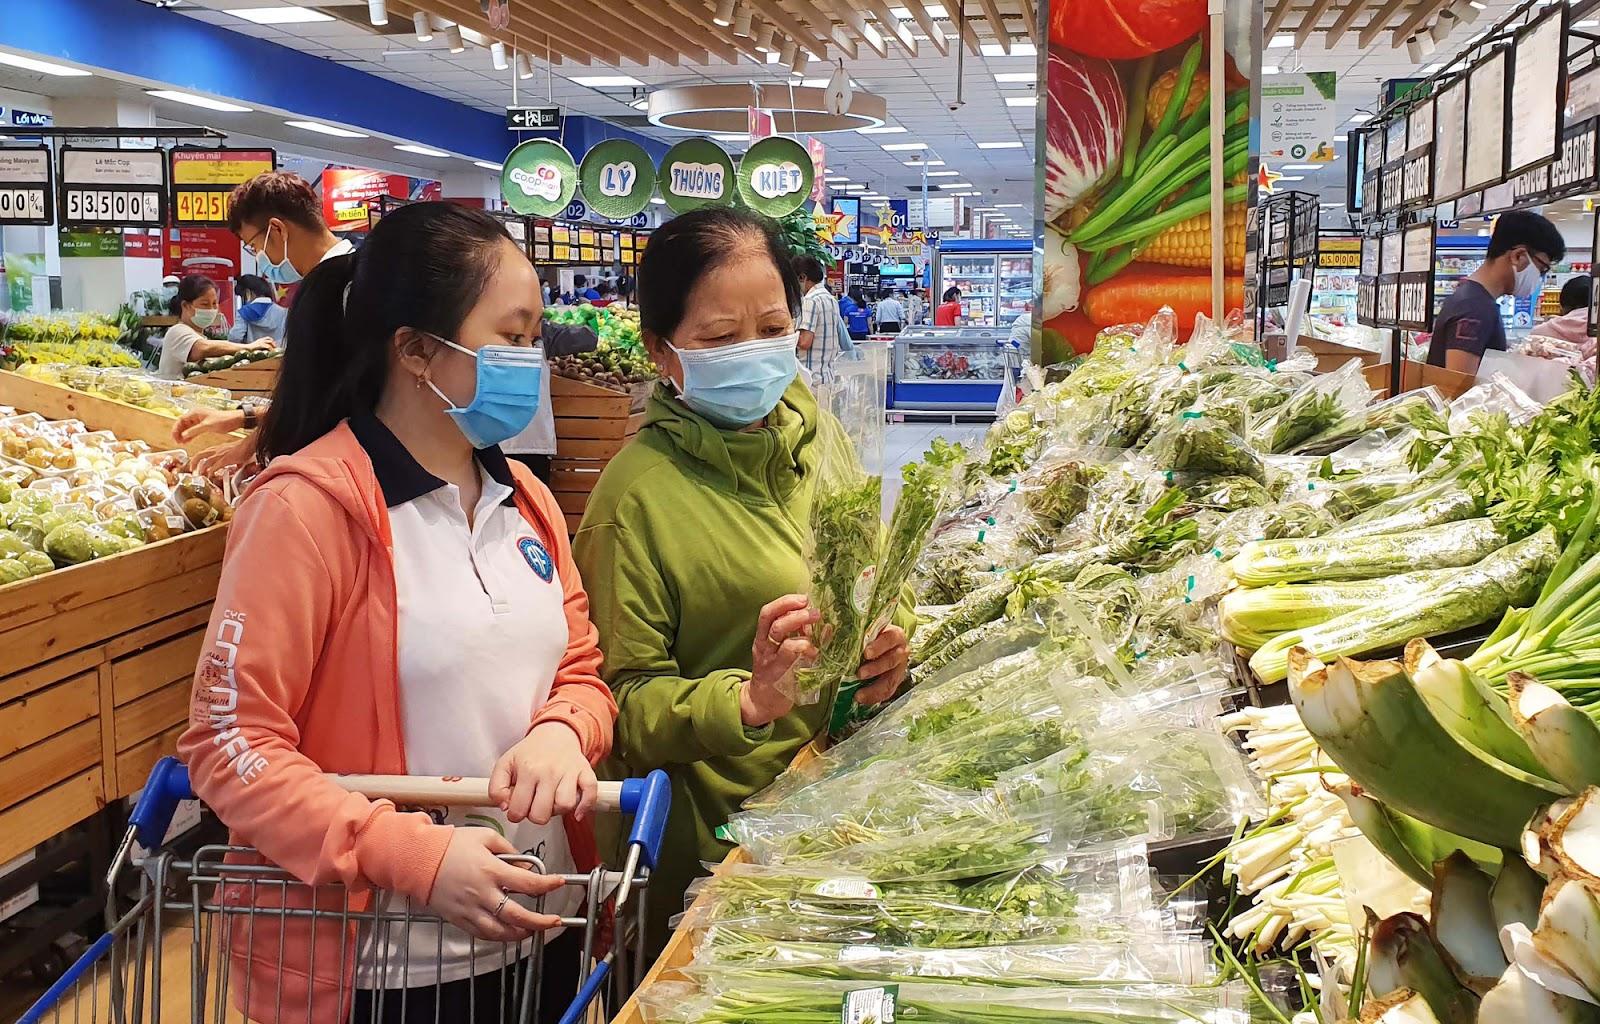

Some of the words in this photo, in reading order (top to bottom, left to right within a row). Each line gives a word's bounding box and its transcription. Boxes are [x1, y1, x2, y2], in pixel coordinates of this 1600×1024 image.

[541, 114, 554, 122] EXIT
[605, 164, 631, 192] LÝ
[70, 194, 140, 215] 53.500
[567, 206, 584, 217] 02
[631, 216, 647, 227] 04
[891, 214, 906, 226] 01
